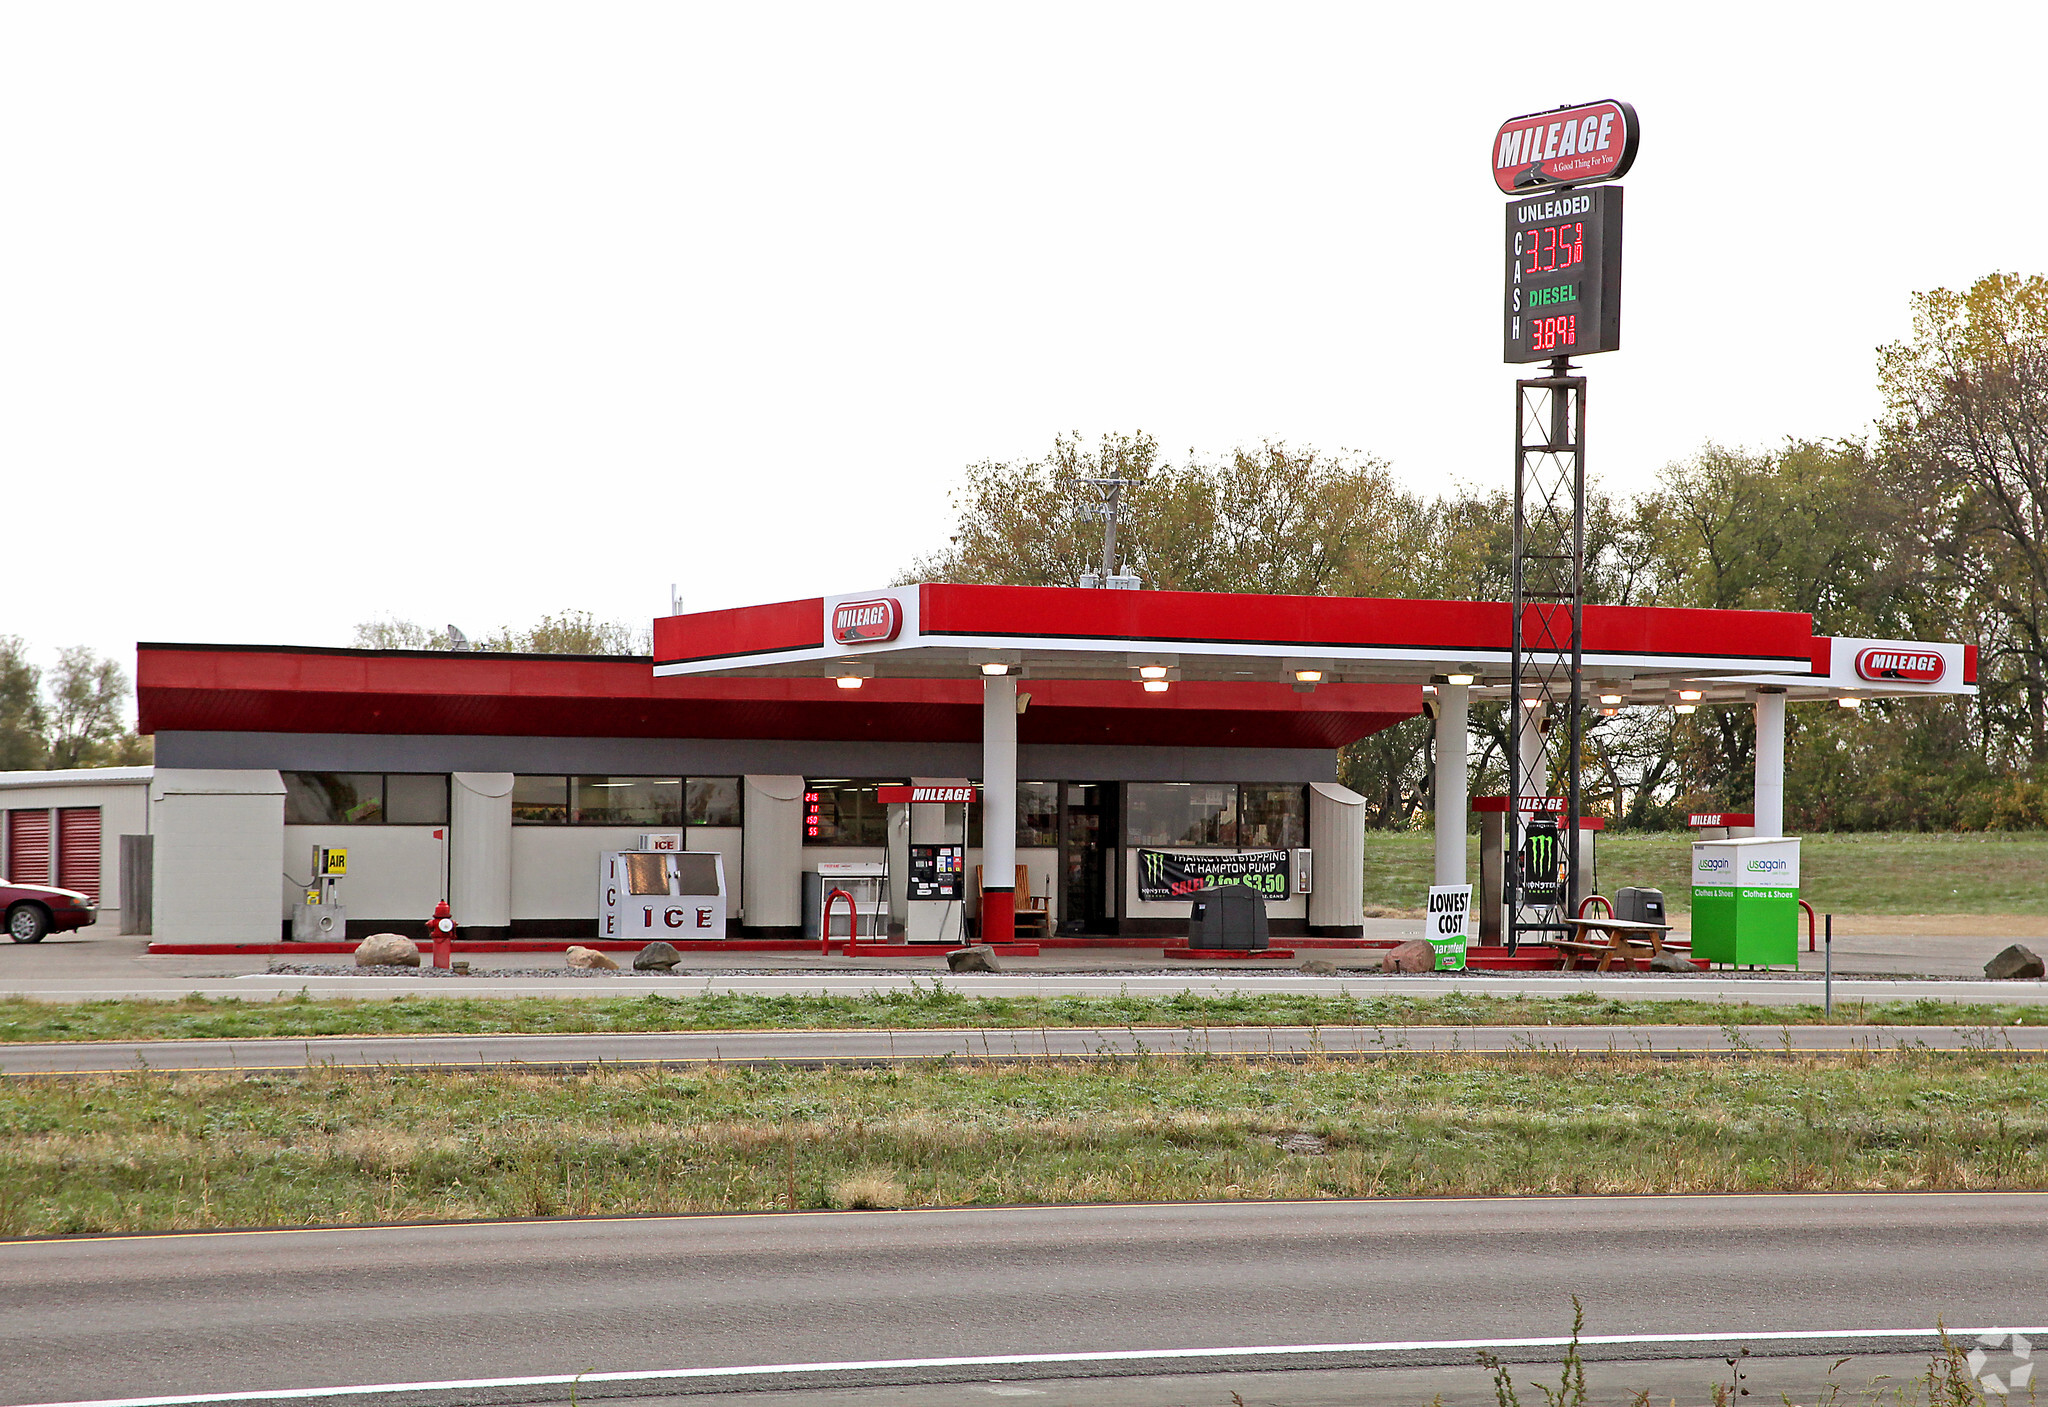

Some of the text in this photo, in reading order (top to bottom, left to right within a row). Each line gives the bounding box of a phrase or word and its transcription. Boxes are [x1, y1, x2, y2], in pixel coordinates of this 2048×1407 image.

[1496, 112, 1616, 170] MILEAGE
[1553, 154, 1614, 173] A Good Thing For You
[1518, 195, 1590, 224] UNLEADED
[1525, 223, 1573, 274] 3.35
[1512, 231, 1523, 340] CASH
[1529, 284, 1577, 307] DIESEL
[1532, 315, 1568, 351] 3.89
[836, 606, 885, 629] MILEAGE
[1871, 653, 1937, 672] MILEAGE
[912, 788, 972, 801] MILEAGE
[1690, 814, 1721, 826] MILEAGE
[807, 826, 819, 836] 55
[654, 841, 674, 850] ICE
[329, 855, 345, 868] AIR
[1183, 862, 1277, 873] AT HAMPTON PUMP
[1699, 858, 1729, 872] usagain
[1749, 858, 1787, 873] usagain
[1205, 874, 1215, 888] 2
[1242, 873, 1285, 893] $3.50
[1429, 892, 1469, 913] LOWEST
[1694, 889, 1734, 898] Clothes & Shoes
[1742, 890, 1793, 898] Clothes & Shoes
[642, 904, 714, 928] ICE
[1438, 914, 1463, 934] COST
[1432, 942, 1465, 954] uaranteed
